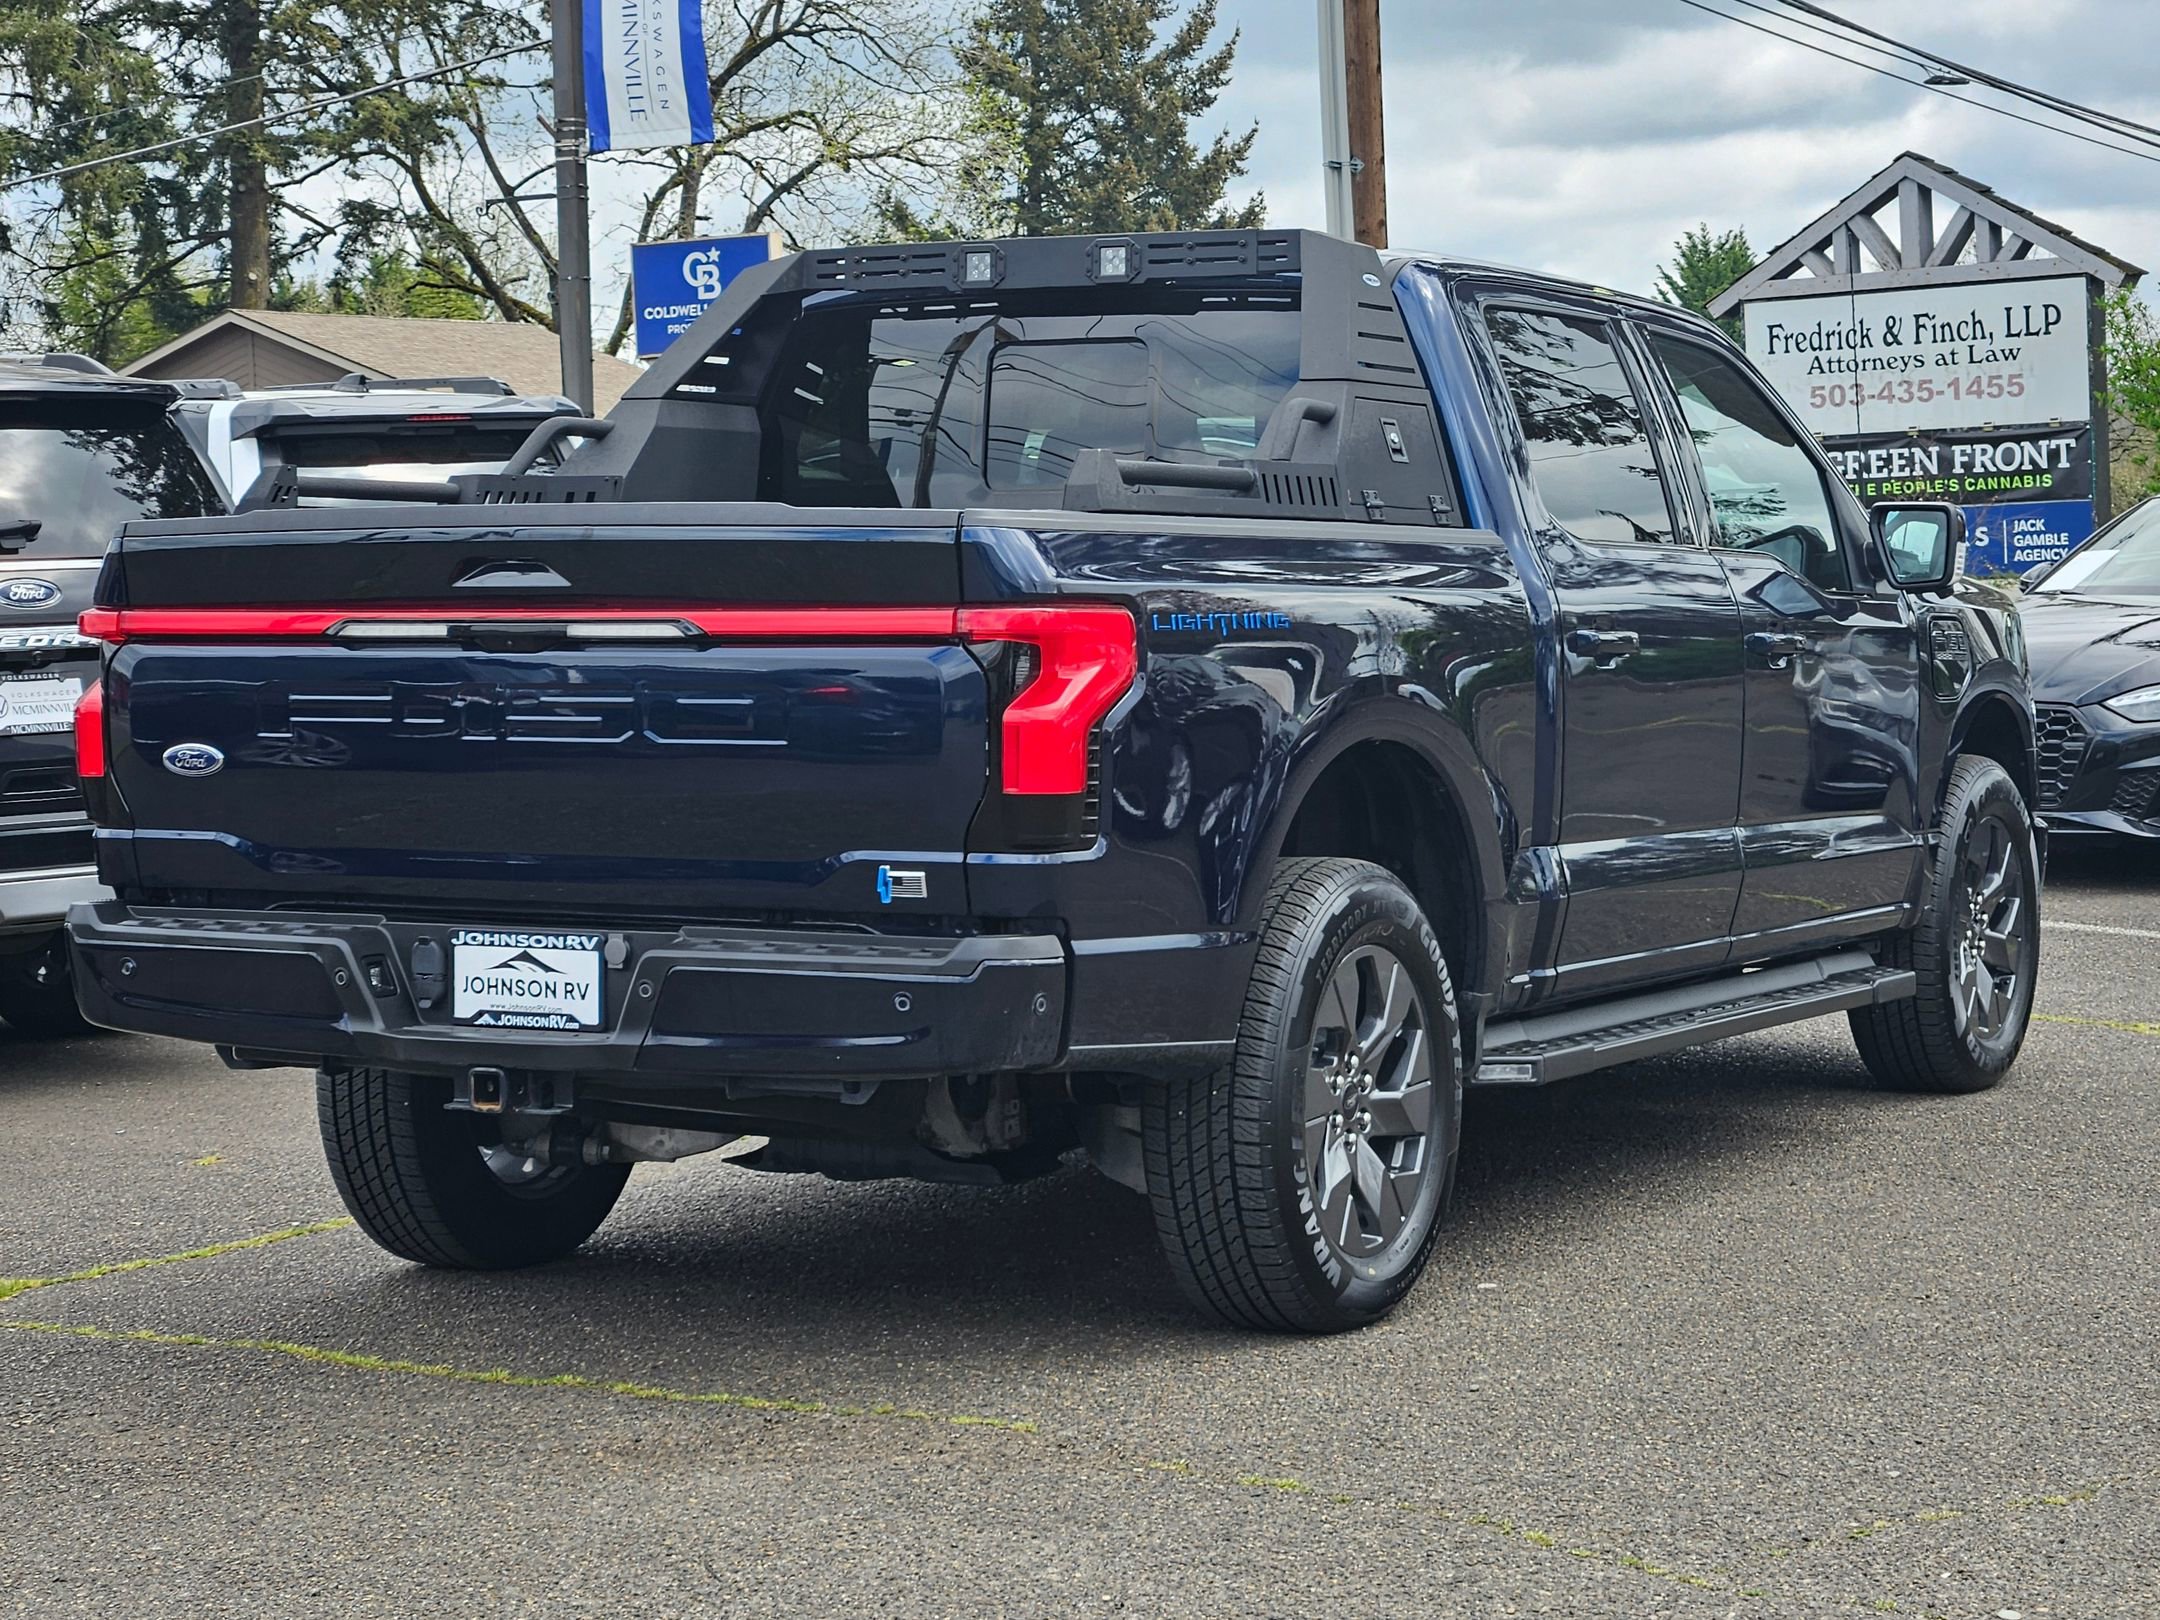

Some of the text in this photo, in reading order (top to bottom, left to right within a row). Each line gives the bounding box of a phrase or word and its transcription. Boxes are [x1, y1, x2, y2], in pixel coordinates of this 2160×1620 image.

[667, 323, 693, 335] PRO
[1766, 303, 2062, 355] Fredrick & Finch, LLP
[1806, 344, 2022, 376] Attorneys at Law
[1809, 373, 2026, 410] 503-435-1455
[1951, 438, 2077, 474] FRONT
[1882, 478, 1960, 495] PEOPLE'S
[1964, 474, 2053, 492] CANNABIS
[2013, 518, 2046, 533] JACK
[2013, 532, 2069, 547] GAMBLE
[2013, 548, 2069, 562] AGENCY
[9, 582, 46, 601] Ford
[1152, 612, 1290, 637] LIGHTNING
[12, 703, 76, 716] MCMINNVIL
[174, 750, 209, 768] Ford
[463, 976, 590, 1001] JOHNSON RV
